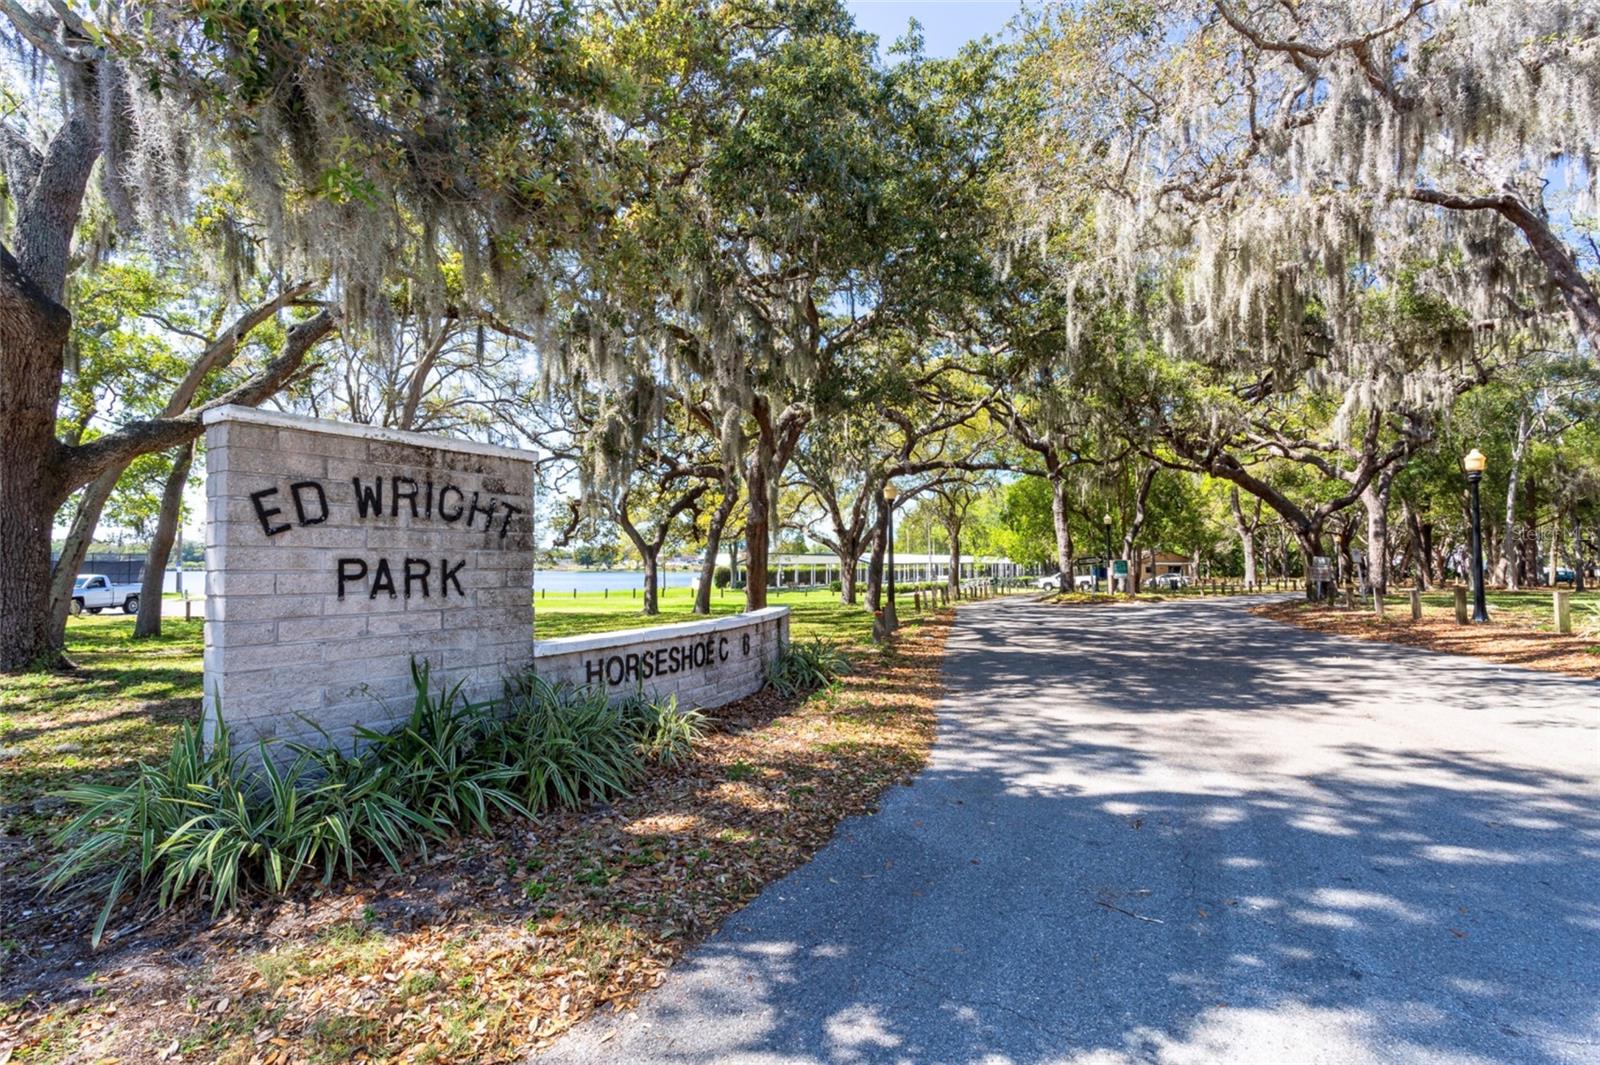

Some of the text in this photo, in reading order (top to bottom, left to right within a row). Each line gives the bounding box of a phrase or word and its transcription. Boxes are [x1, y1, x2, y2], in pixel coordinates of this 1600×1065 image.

[250, 475, 522, 539] ED WRIGHT
[337, 558, 466, 601] PARK
[586, 639, 715, 687] HORSESHOE
